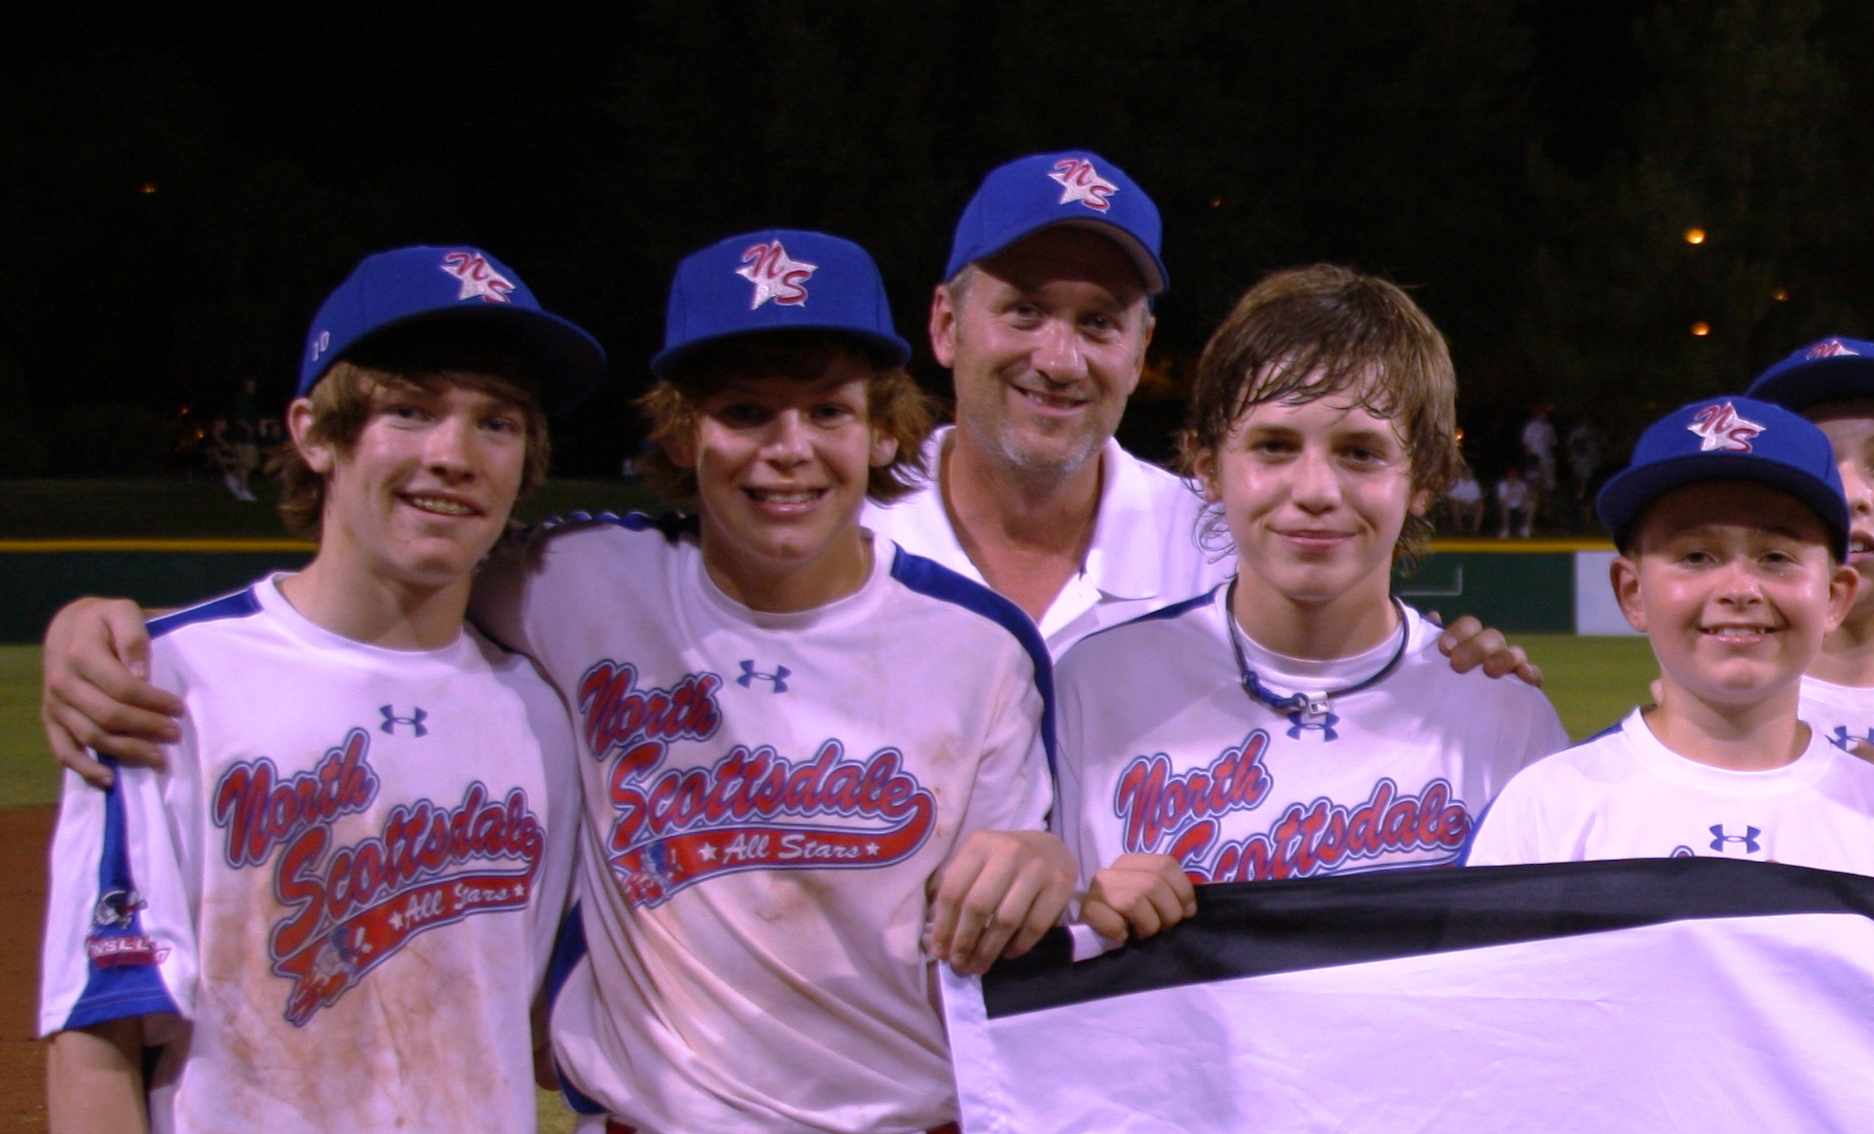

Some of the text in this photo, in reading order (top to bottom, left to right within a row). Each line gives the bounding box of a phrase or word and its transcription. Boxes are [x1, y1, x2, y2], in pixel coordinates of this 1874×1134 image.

[578, 659, 723, 761] North
[213, 727, 379, 869] North
[609, 738, 920, 853] Scottsdale
[1115, 728, 1272, 854] North
[272, 781, 545, 962] Scottsdale
[722, 834, 860, 864] All Stars
[405, 888, 443, 929] All
